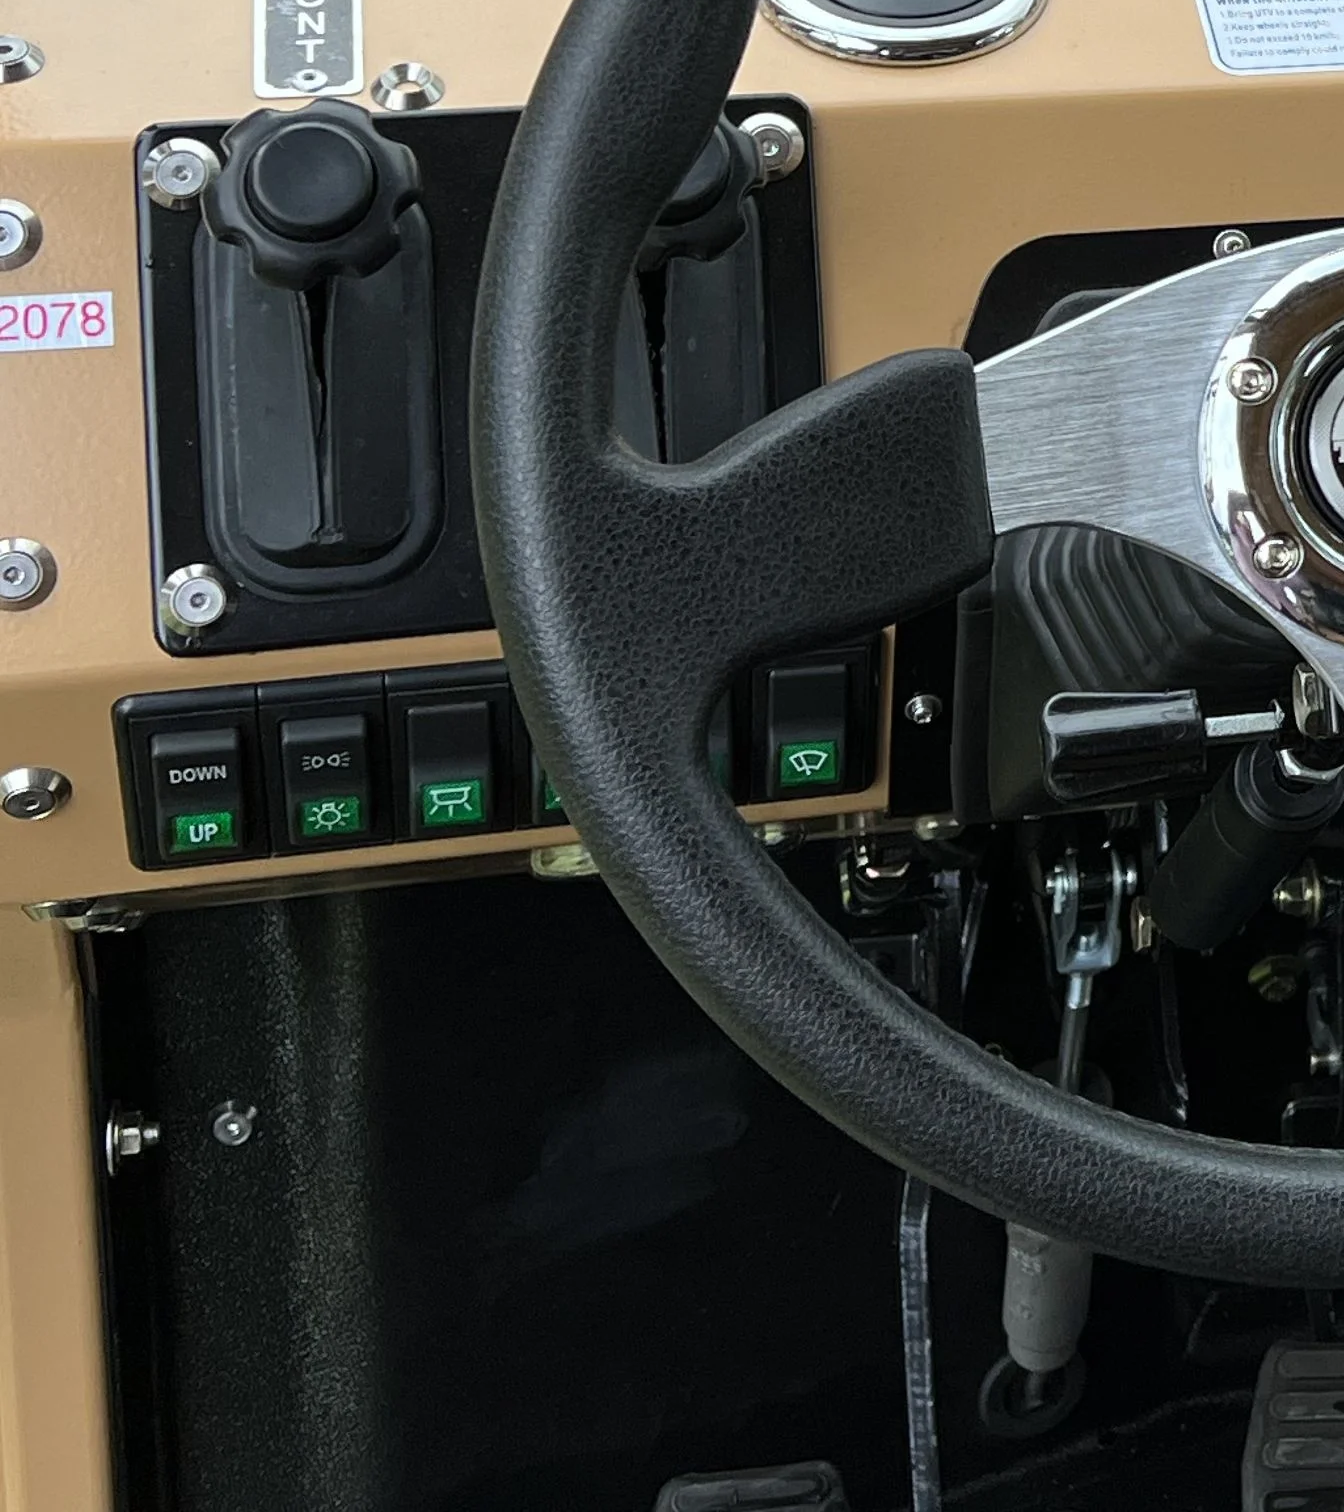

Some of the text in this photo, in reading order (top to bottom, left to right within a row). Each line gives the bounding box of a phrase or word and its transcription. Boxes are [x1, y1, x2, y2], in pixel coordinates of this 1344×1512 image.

[0, 300, 105, 342] 2078
[168, 764, 228, 785] DOWN
[189, 822, 219, 843] UP
